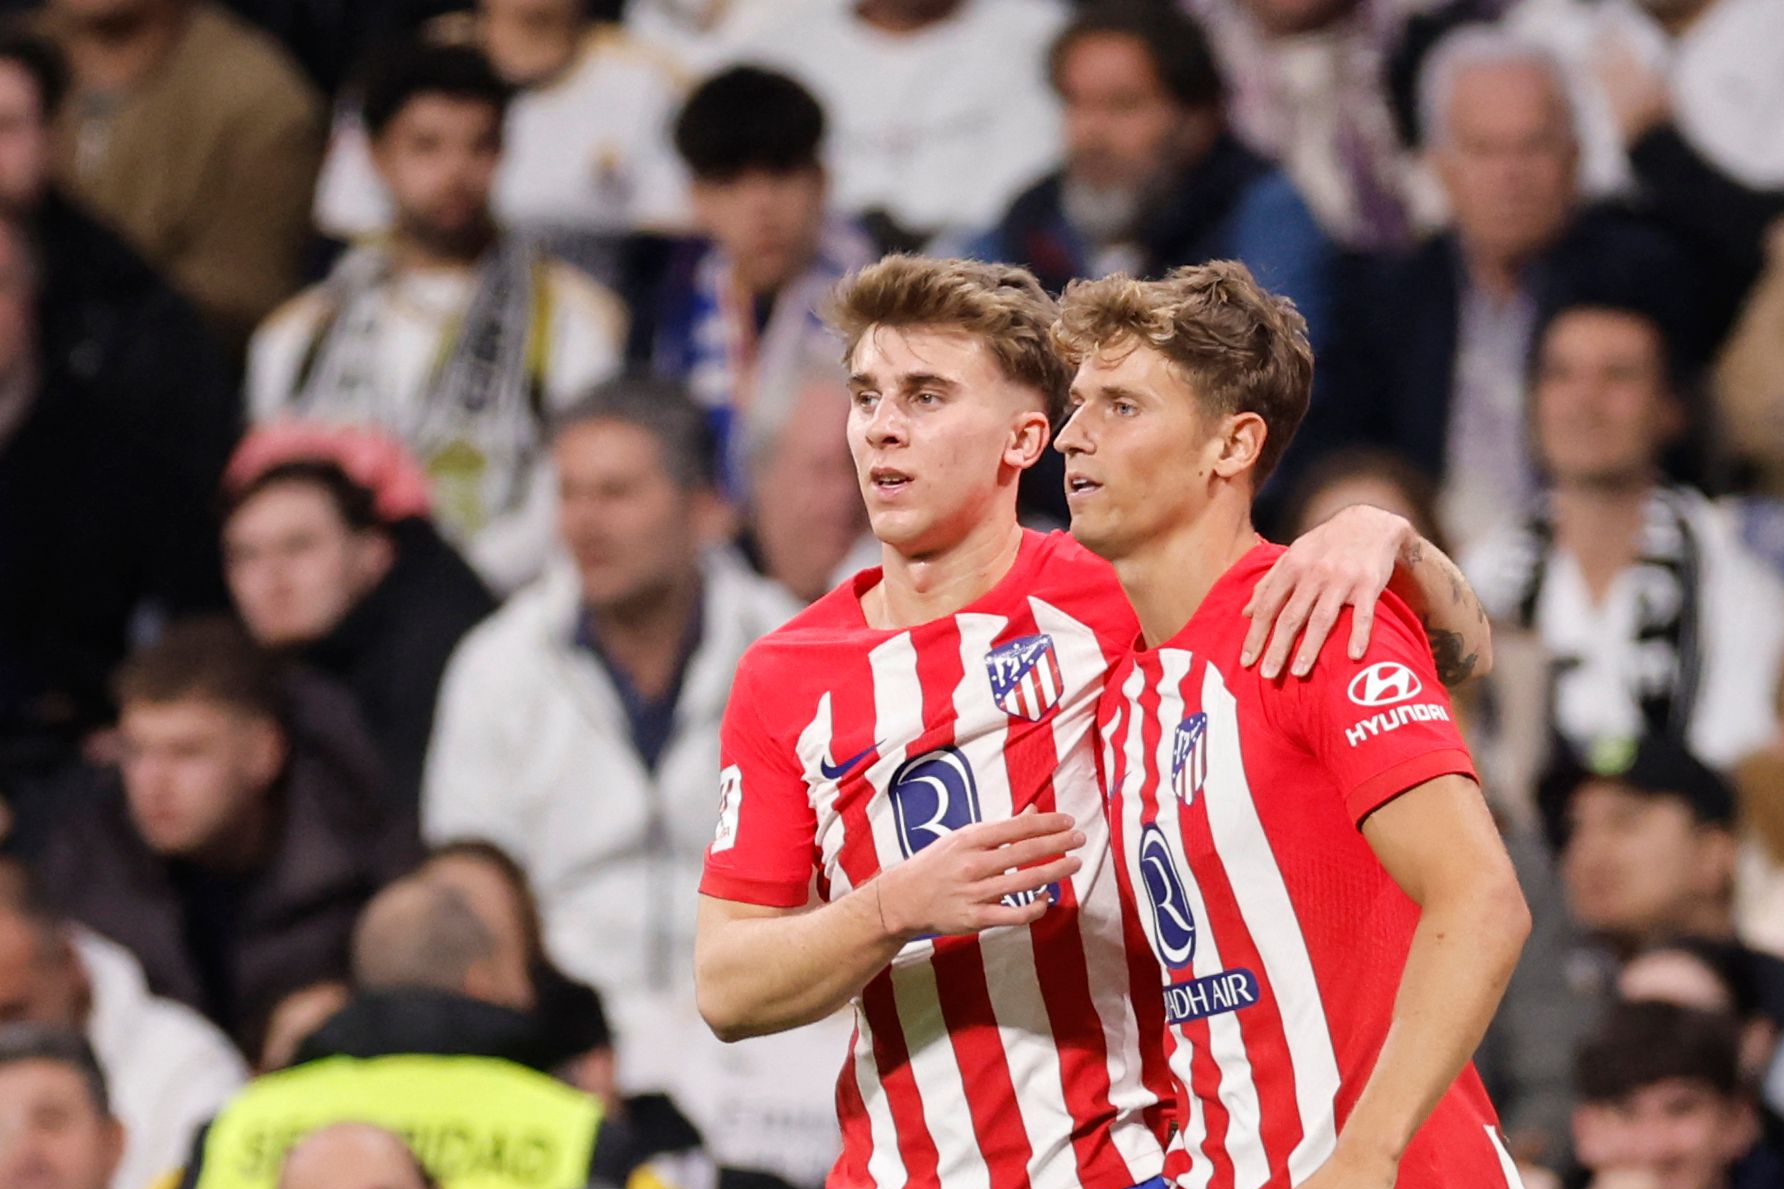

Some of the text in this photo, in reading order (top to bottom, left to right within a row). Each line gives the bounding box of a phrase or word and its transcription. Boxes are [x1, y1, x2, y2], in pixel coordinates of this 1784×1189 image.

[1345, 703, 1450, 748] HYUNDAI
[1164, 973, 1254, 1020] ADH AIR
